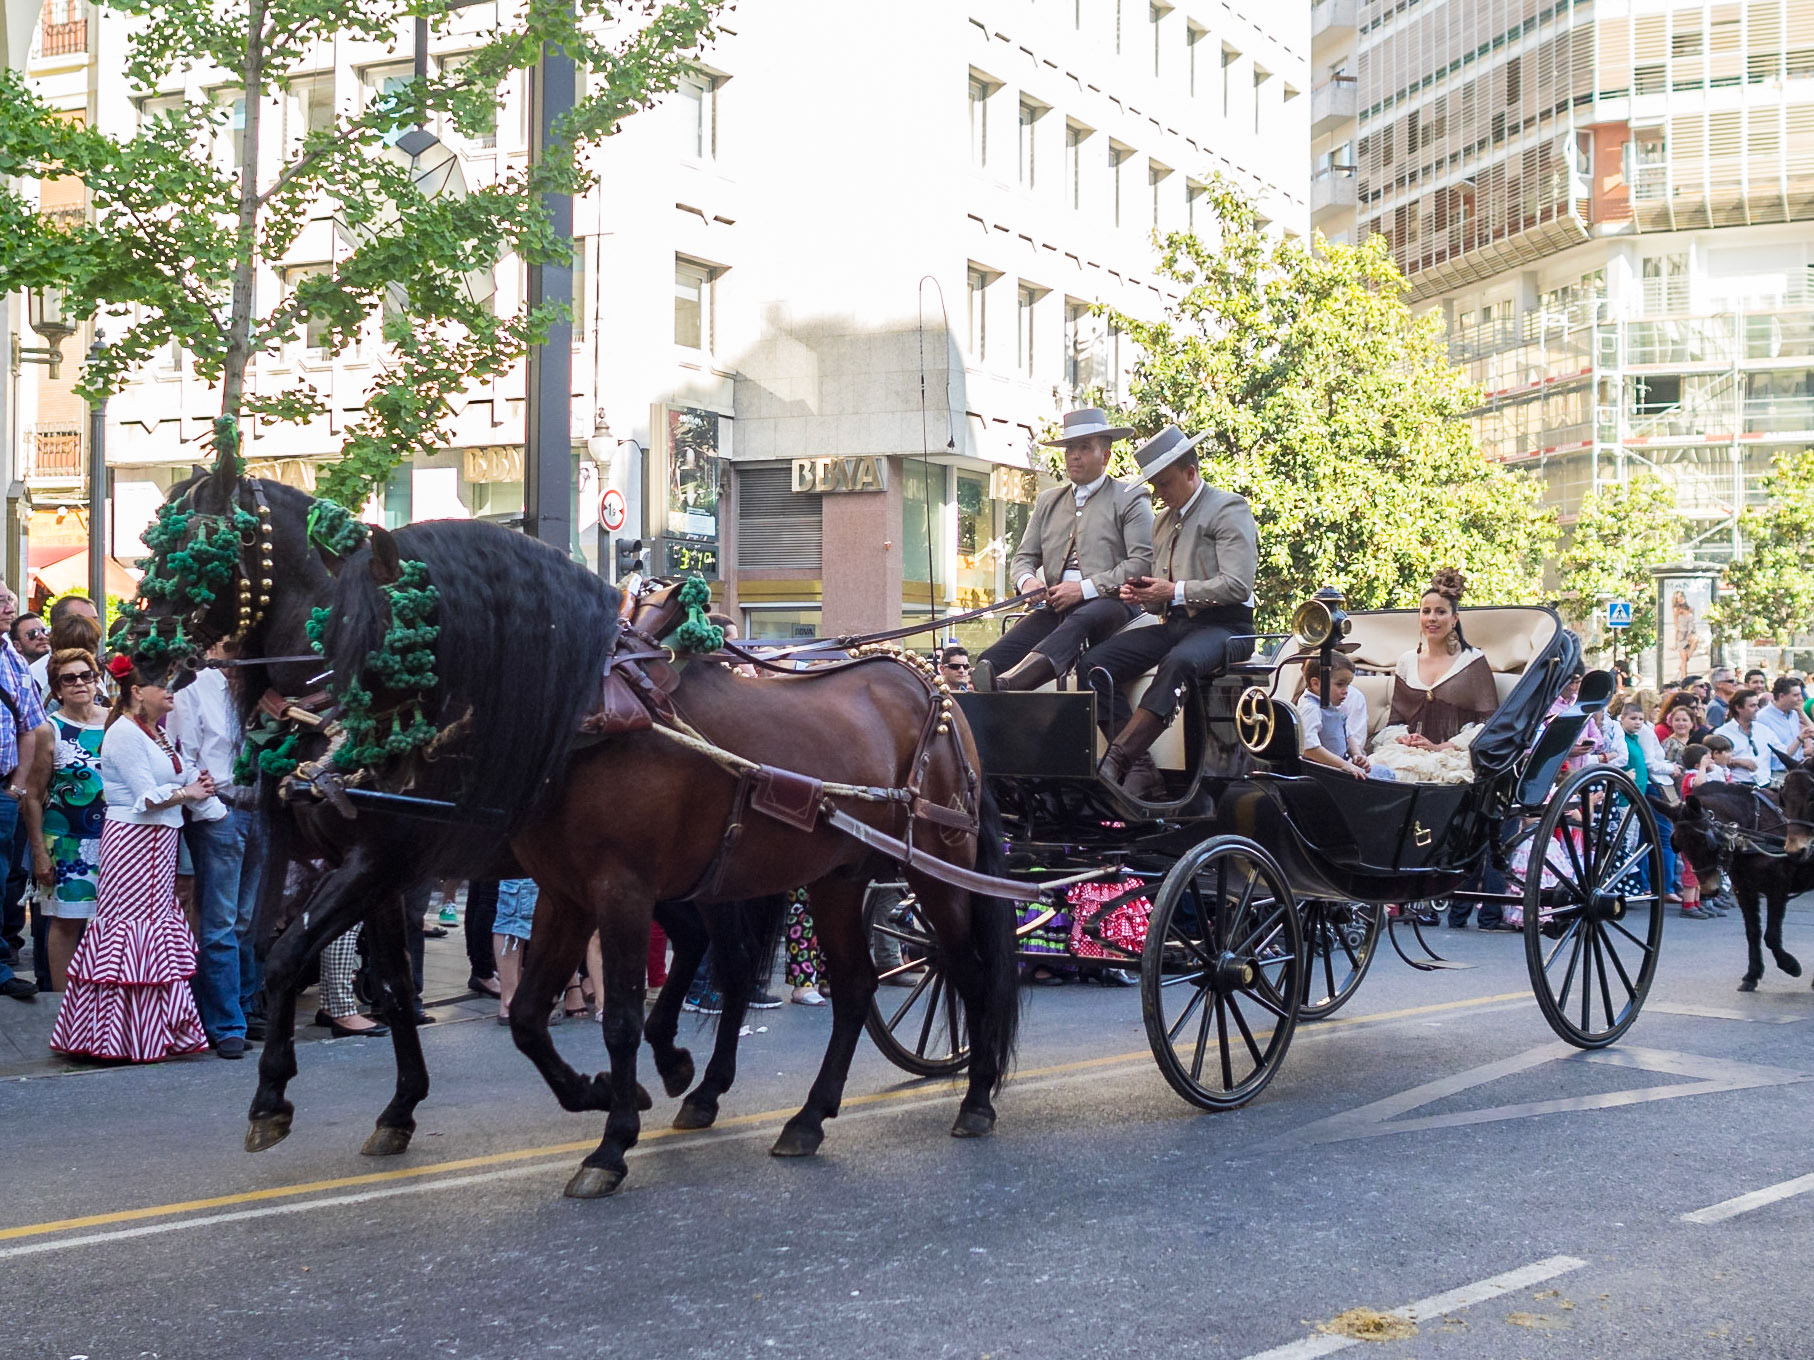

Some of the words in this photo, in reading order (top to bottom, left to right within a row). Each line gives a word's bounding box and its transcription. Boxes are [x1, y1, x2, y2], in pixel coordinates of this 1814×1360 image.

[463, 446, 524, 482] BBV
[791, 456, 884, 492] BBVA
[1665, 582, 1711, 591] MANO
